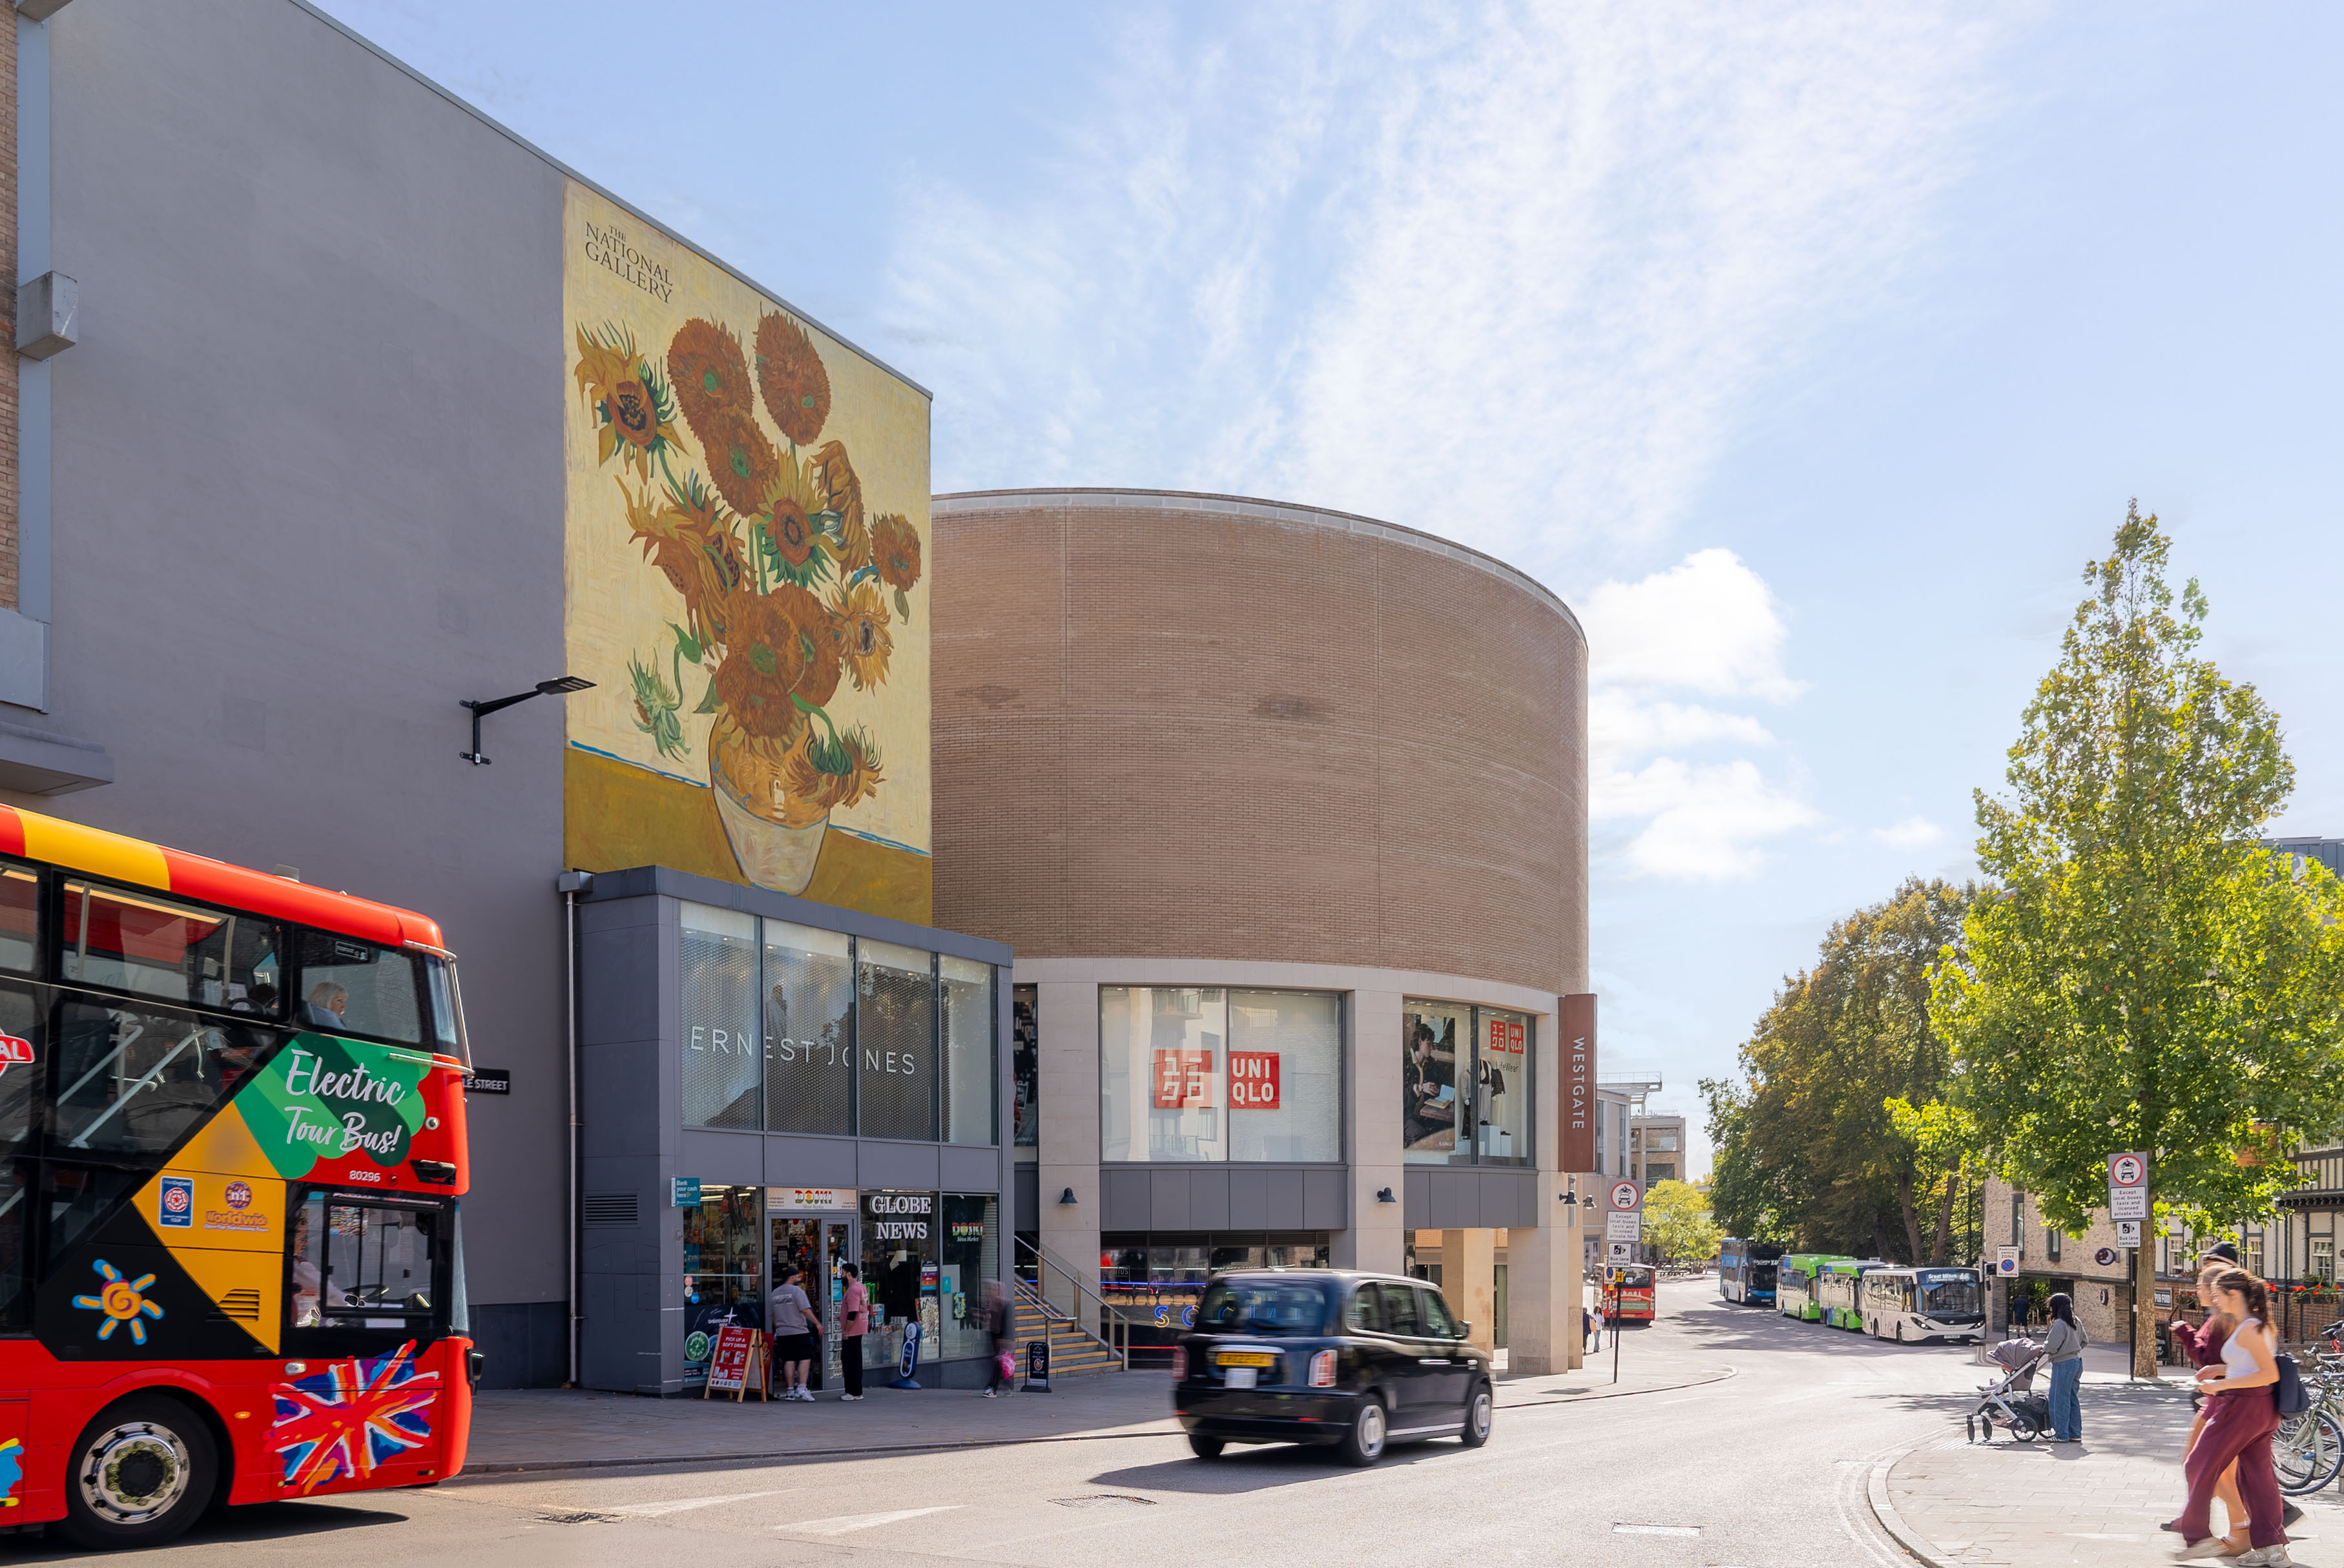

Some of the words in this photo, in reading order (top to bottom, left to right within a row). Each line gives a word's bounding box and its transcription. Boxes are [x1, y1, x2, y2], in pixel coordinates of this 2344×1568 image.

[608, 225, 626, 242] THE
[586, 221, 673, 286] NATIONAL
[585, 242, 672, 304] GALLERY
[1510, 1027, 1522, 1038] UNI
[690, 1026, 815, 1063] ERNEST
[1510, 1038, 1522, 1051] QLO
[286, 1048, 406, 1106] Electric
[1232, 1058, 1270, 1078] UNI
[474, 1079, 508, 1091] STREET
[1572, 1037, 1585, 1129] WESTGATE
[1232, 1082, 1274, 1105] QLO
[284, 1106, 338, 1145] Tour
[339, 1111, 402, 1154] Bus!
[348, 1170, 381, 1182] 80296
[871, 1196, 931, 1213] GLOBE
[876, 1222, 927, 1239] NEWS
